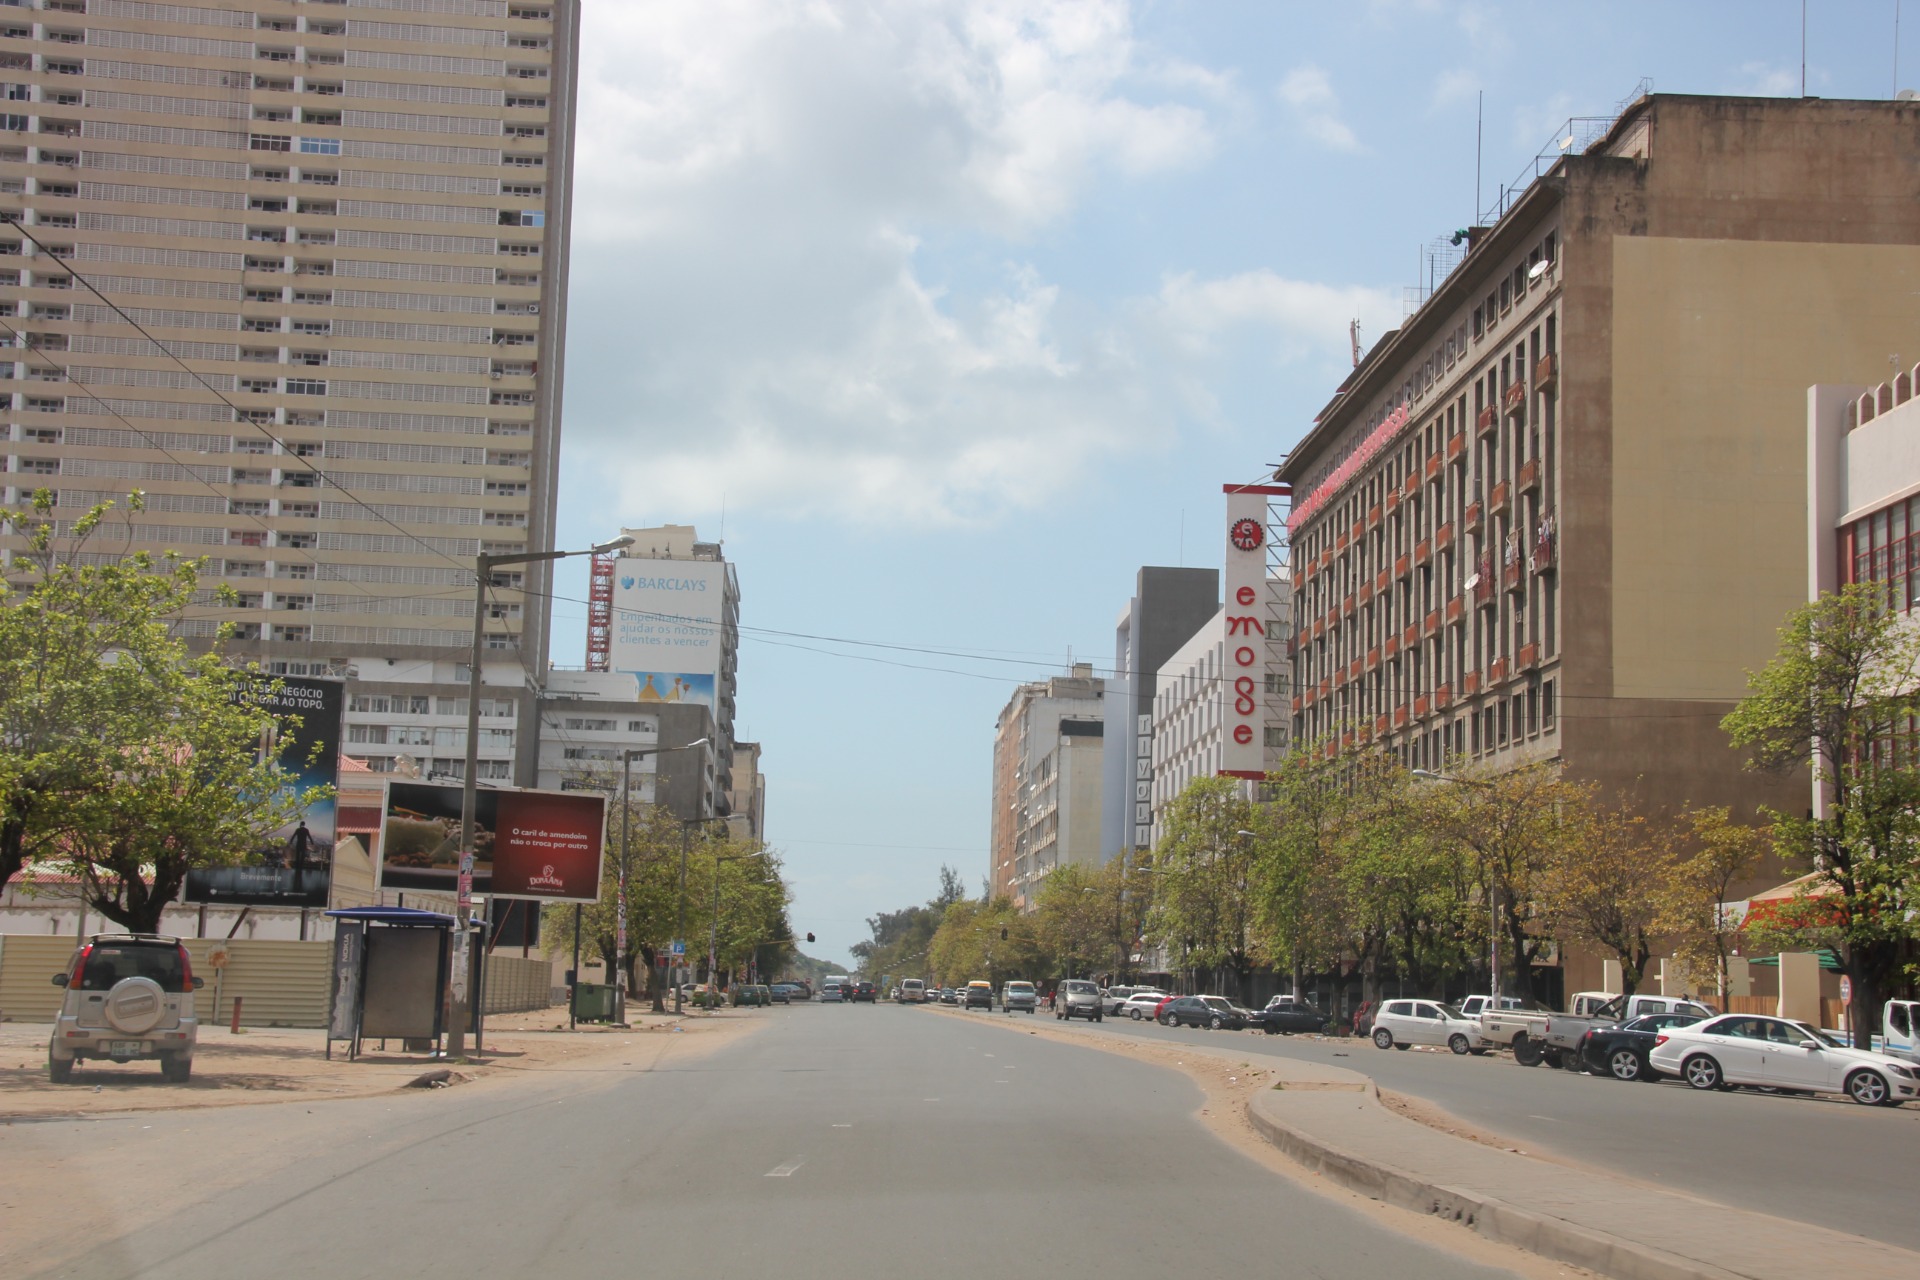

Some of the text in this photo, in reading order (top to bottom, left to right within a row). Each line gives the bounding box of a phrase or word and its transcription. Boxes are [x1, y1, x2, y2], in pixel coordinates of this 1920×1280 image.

[638, 577, 706, 592] BARCLAYS
[620, 611, 712, 625] Empenhados em
[619, 622, 714, 636] ajudar os nossos
[619, 634, 709, 647] clientes a vencer
[279, 684, 323, 699] NEGÓCIO
[238, 692, 279, 706] CHEGAR
[281, 697, 296, 708] AO
[297, 698, 325, 711] TOPO.
[1138, 717, 1149, 843] TIVOLI
[538, 829, 548, 837] de
[553, 841, 566, 849] por
[240, 872, 282, 882] Brevemente
[342, 933, 350, 962] NOKIA
